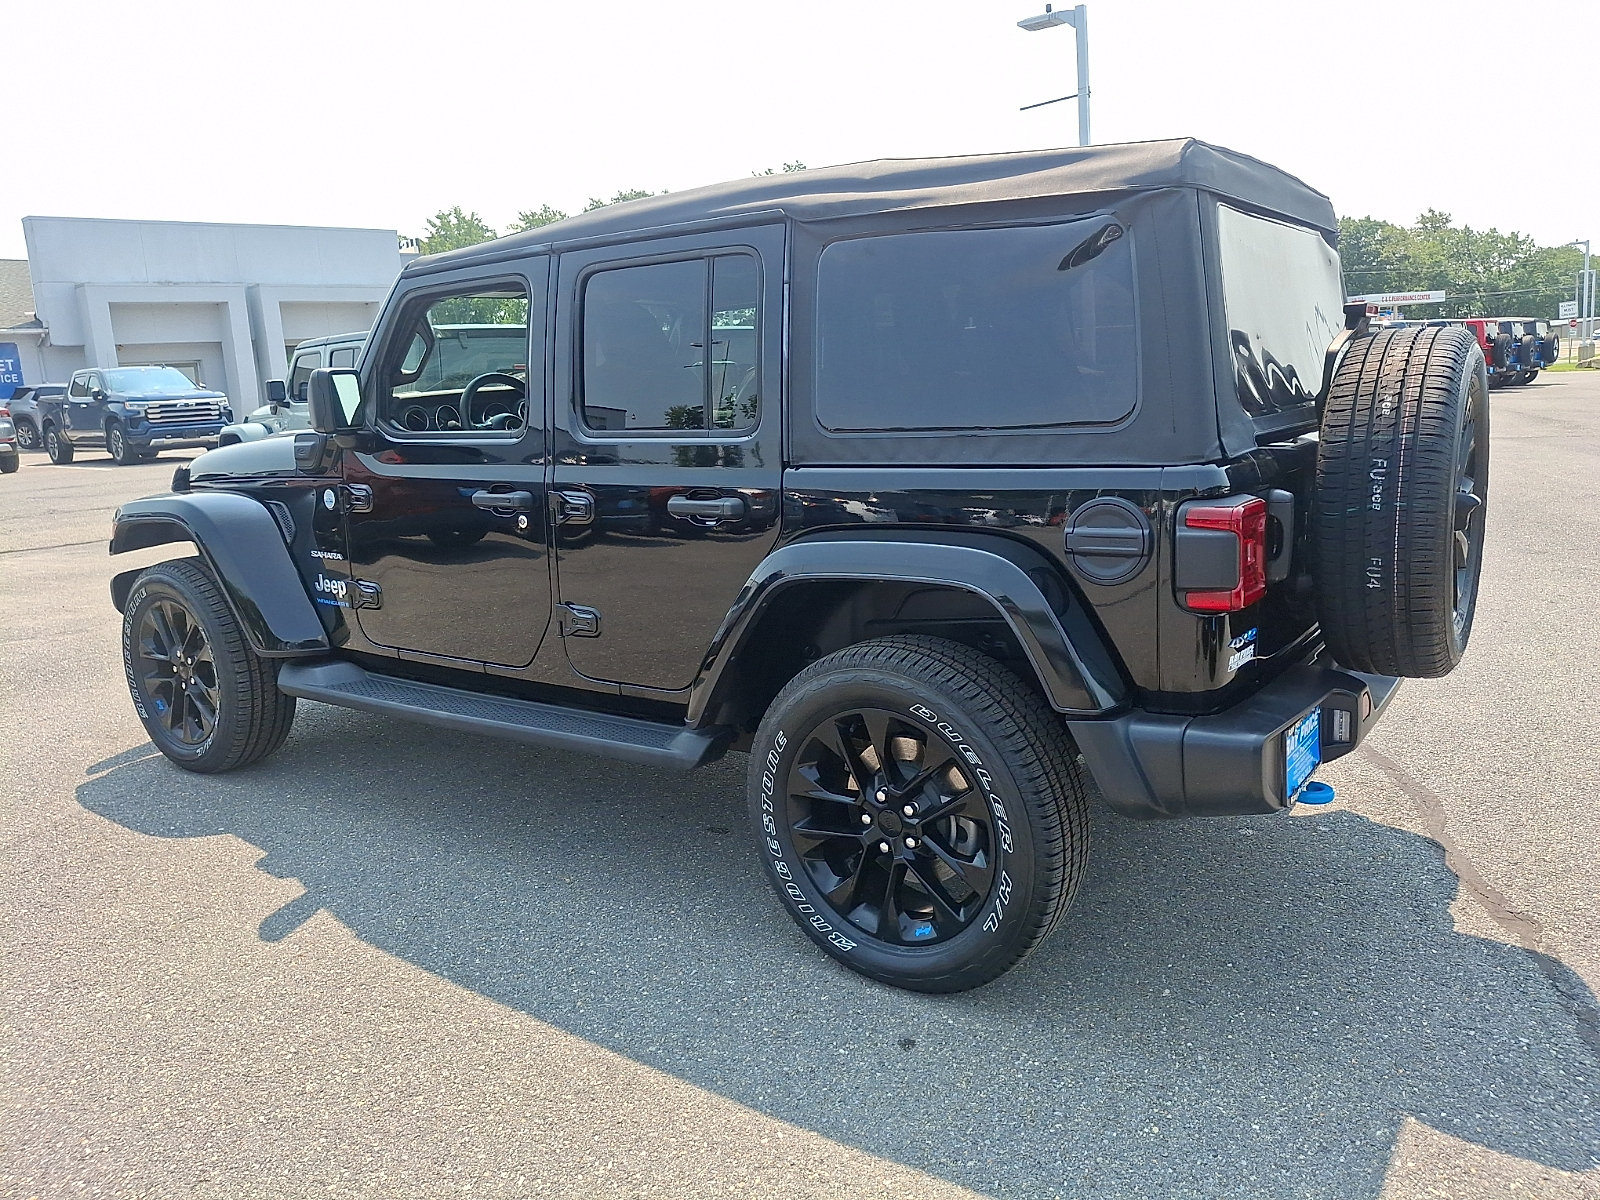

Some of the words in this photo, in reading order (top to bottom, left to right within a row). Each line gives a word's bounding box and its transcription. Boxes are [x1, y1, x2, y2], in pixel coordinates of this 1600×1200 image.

[310, 550, 344, 561] SAHARA
[314, 573, 348, 599] Jeep
[123, 587, 148, 719] BRIDGESTONE
[909, 703, 1014, 854] DUELER
[760, 730, 858, 952] BRIDGESTONE
[982, 869, 1014, 933] H/L
